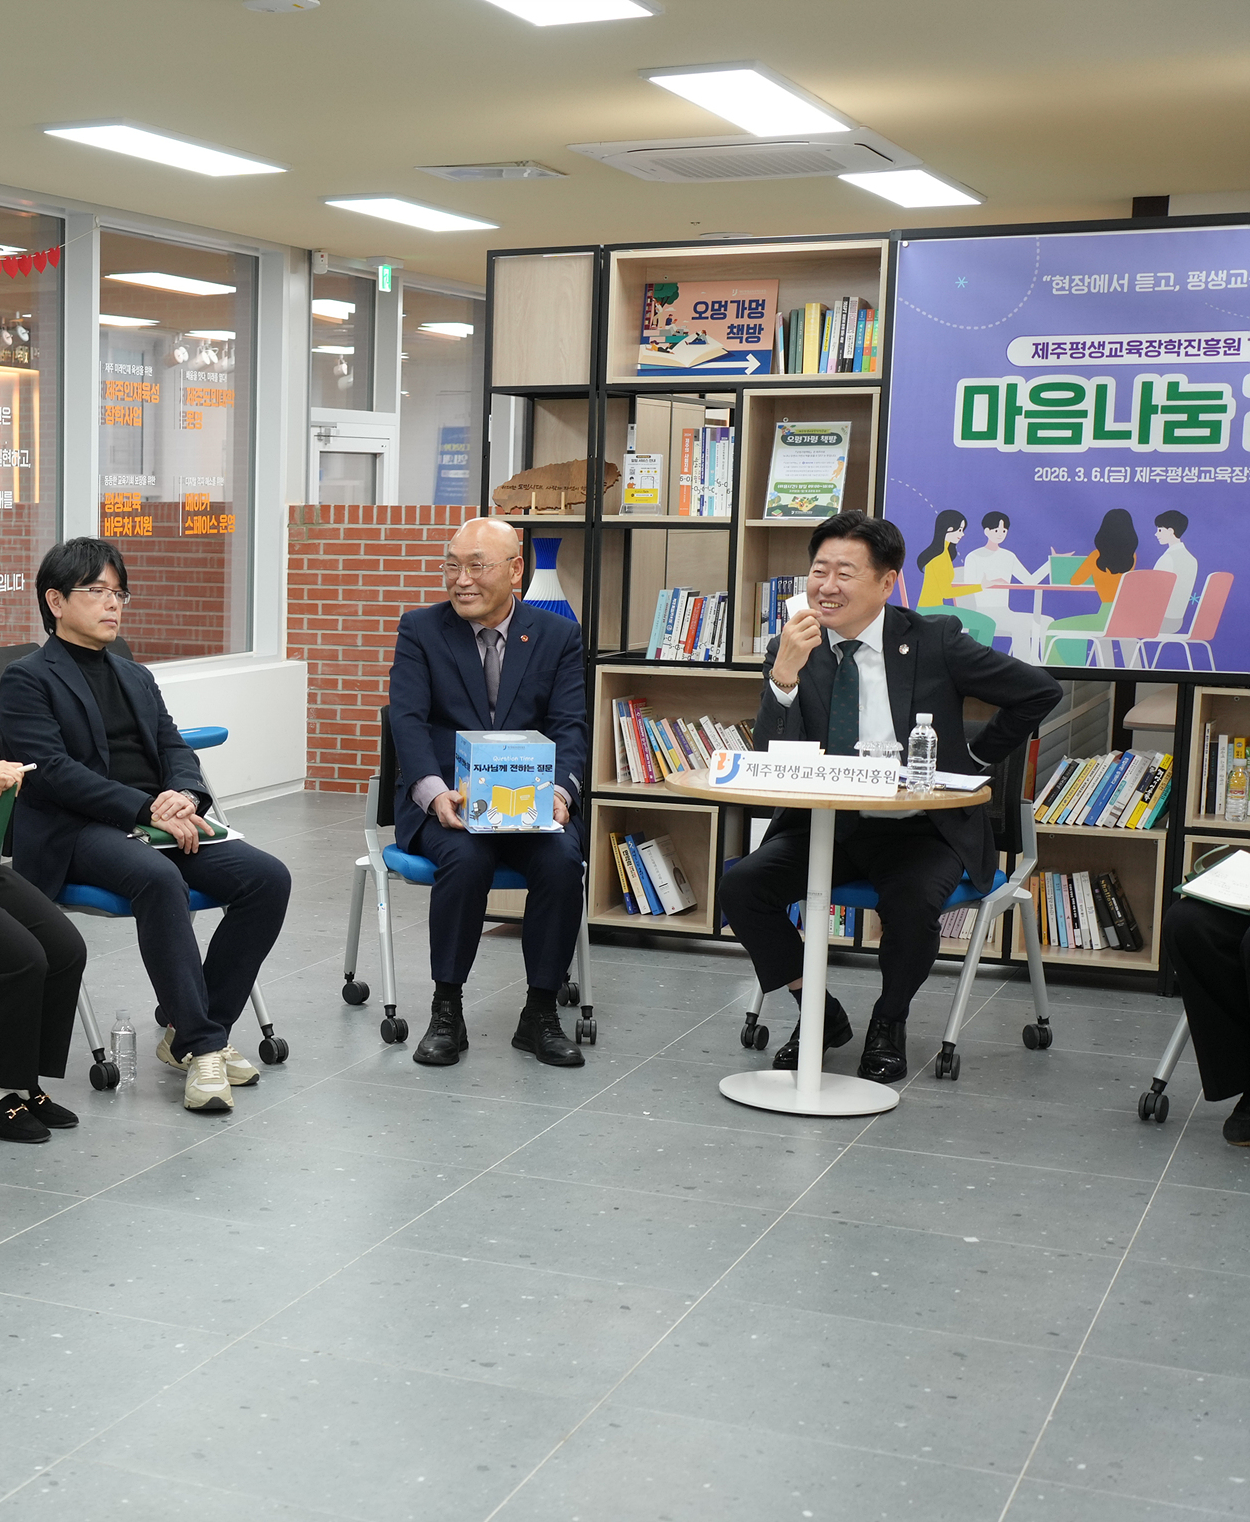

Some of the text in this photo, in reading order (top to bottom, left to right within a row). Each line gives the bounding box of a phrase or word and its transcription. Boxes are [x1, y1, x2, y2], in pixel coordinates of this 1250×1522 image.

[1043, 269, 1250, 296] “현장에서 듣고, 평생교
[691, 299, 766, 321] 오멍가멍
[726, 323, 765, 344] 책방
[1031, 337, 1242, 361] 제주평생교육장학진흥원
[104, 380, 160, 404] 제주인재육성
[185, 387, 235, 408] 제주도민대학
[104, 405, 143, 427] 장학사업
[186, 410, 203, 430] 운영
[959, 379, 1229, 447] 마음나눔
[1034, 466, 1250, 483] 2026. 3. 6.(금) 제주평생교육장
[104, 492, 142, 513] 평생교육
[185, 492, 210, 511] 메이커
[104, 515, 153, 537] 바우처 지원
[184, 514, 236, 535] 스페이스 운영
[473, 764, 553, 773] 지사님께 전하는 질문
[745, 762, 897, 785] 제주평생교육장학진흥원
